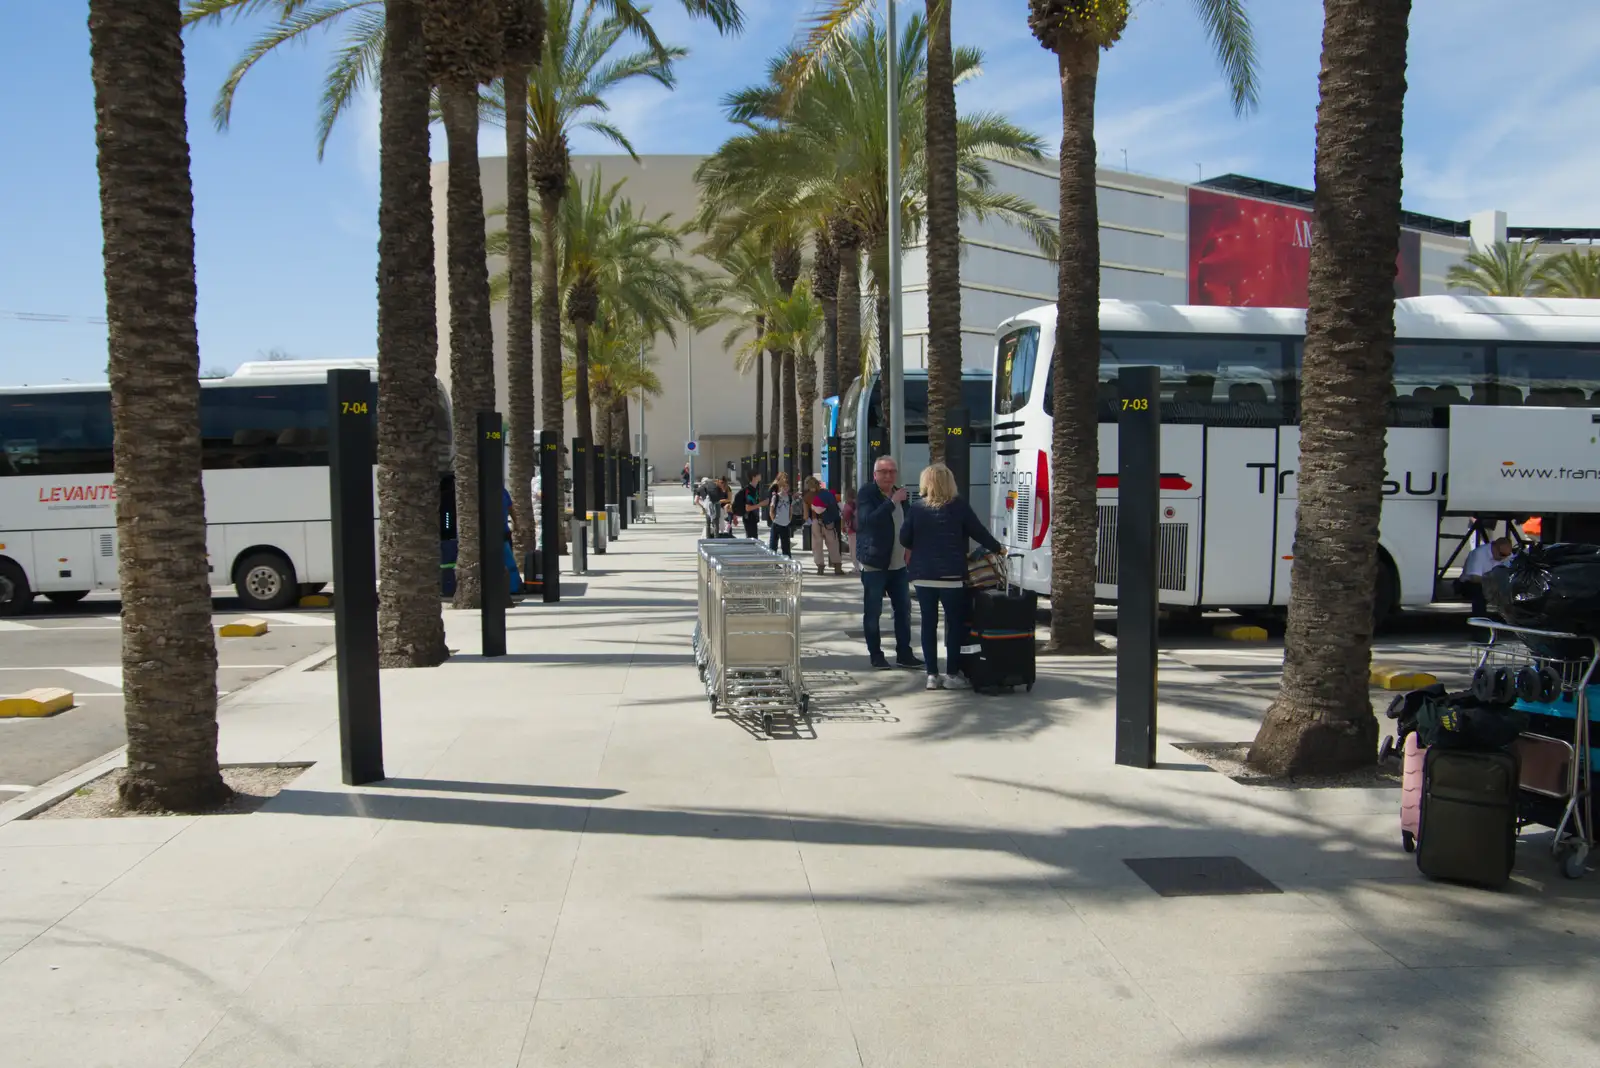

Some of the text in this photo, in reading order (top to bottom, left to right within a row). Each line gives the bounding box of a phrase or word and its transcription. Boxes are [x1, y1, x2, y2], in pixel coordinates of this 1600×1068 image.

[341, 402, 368, 415] 7-04
[1121, 398, 1148, 411] 7-03
[947, 427, 962, 435] 7-05
[1501, 466, 1600, 480] www.tran
